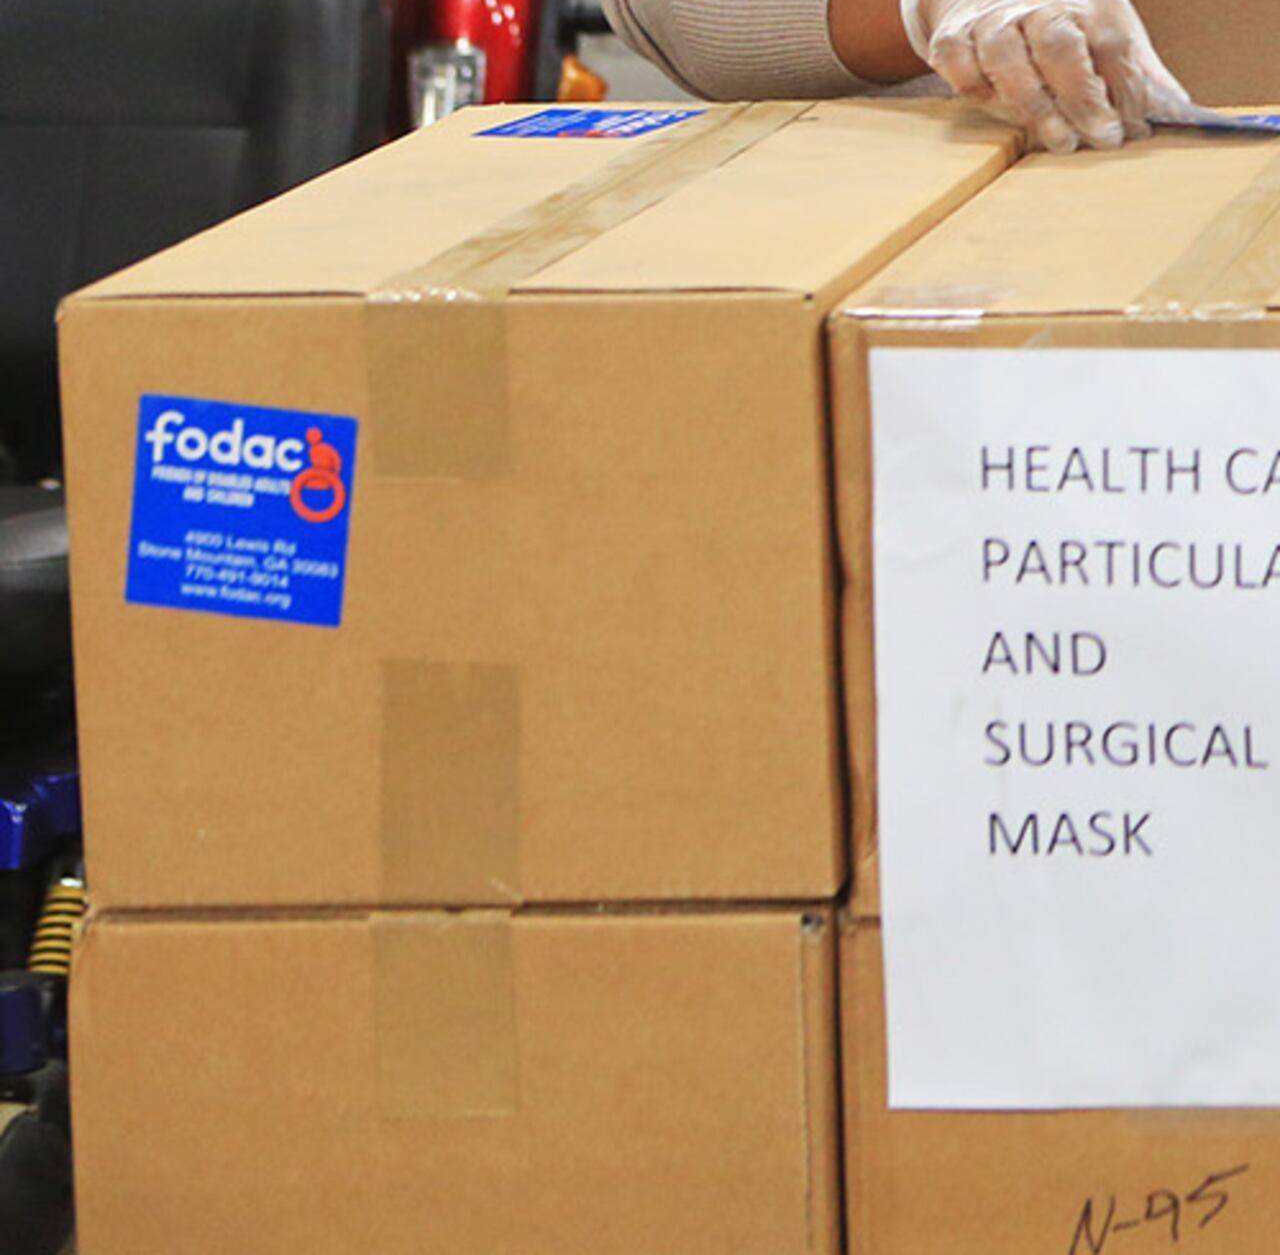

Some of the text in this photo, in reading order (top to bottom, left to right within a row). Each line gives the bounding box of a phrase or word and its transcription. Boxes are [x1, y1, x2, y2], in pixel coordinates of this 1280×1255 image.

[146, 410, 304, 472] fodac
[980, 445, 1202, 494] HEALTH
[137, 541, 182, 560] Stone
[263, 555, 288, 571] GA
[226, 535, 269, 554] Lewis
[273, 540, 296, 557] Rd
[981, 630, 1108, 676] AND
[983, 720, 1270, 769] SURGICAL
[987, 811, 1154, 858] MASK
[1069, 1163, 1249, 1255] N-95
